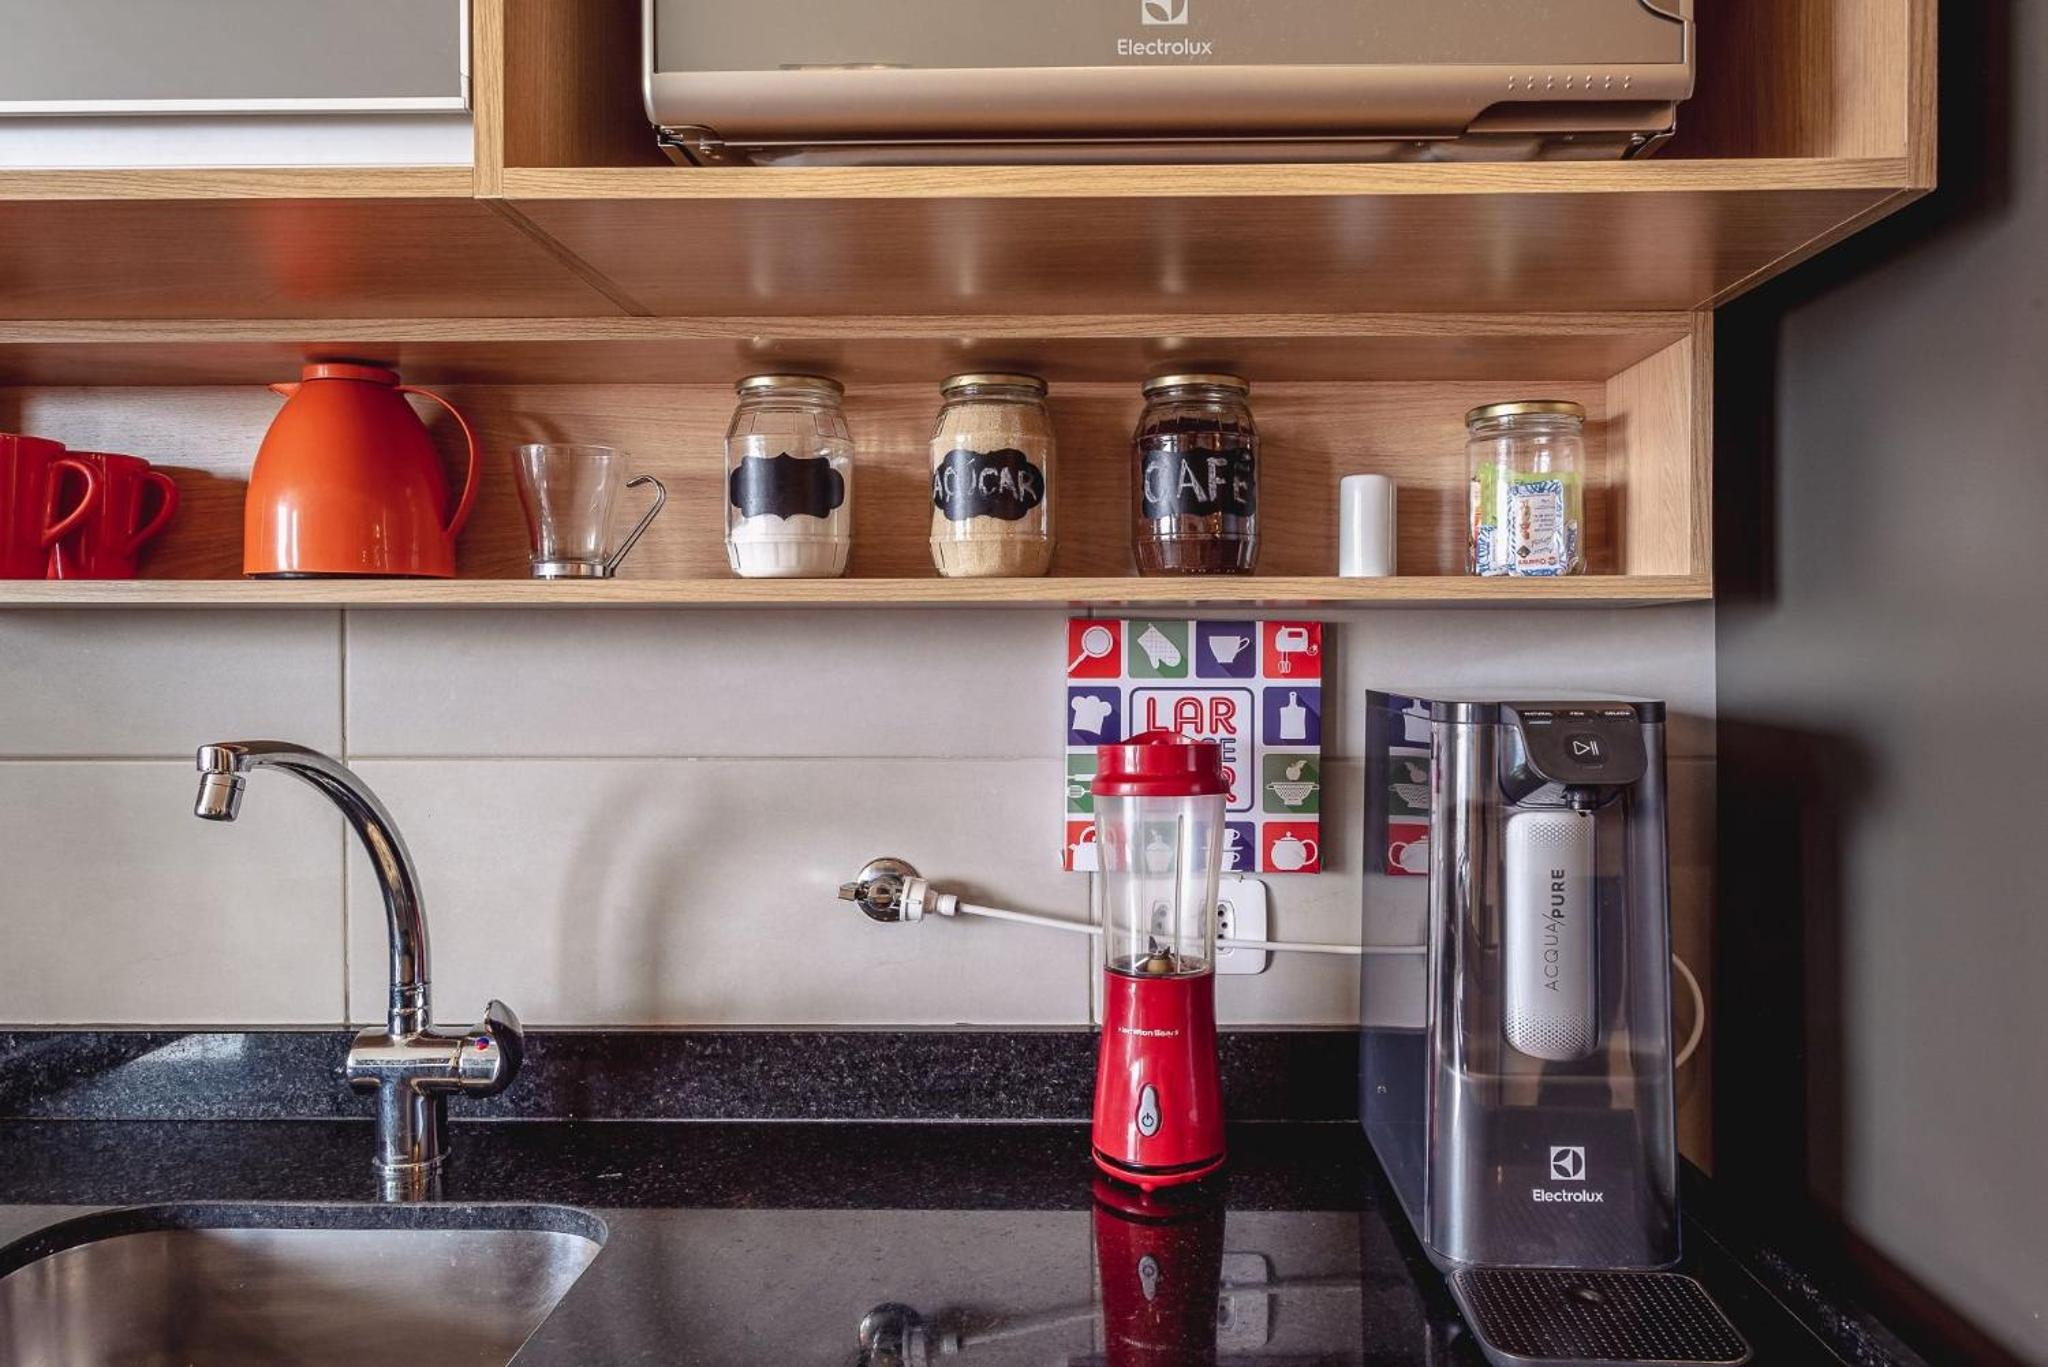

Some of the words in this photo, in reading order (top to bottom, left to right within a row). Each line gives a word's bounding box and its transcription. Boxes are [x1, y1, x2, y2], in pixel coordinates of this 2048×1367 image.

[1117, 38, 1213, 55] Electrolux
[1146, 697, 1237, 734] LAR
[1532, 1189, 1604, 1203] Electrolux
